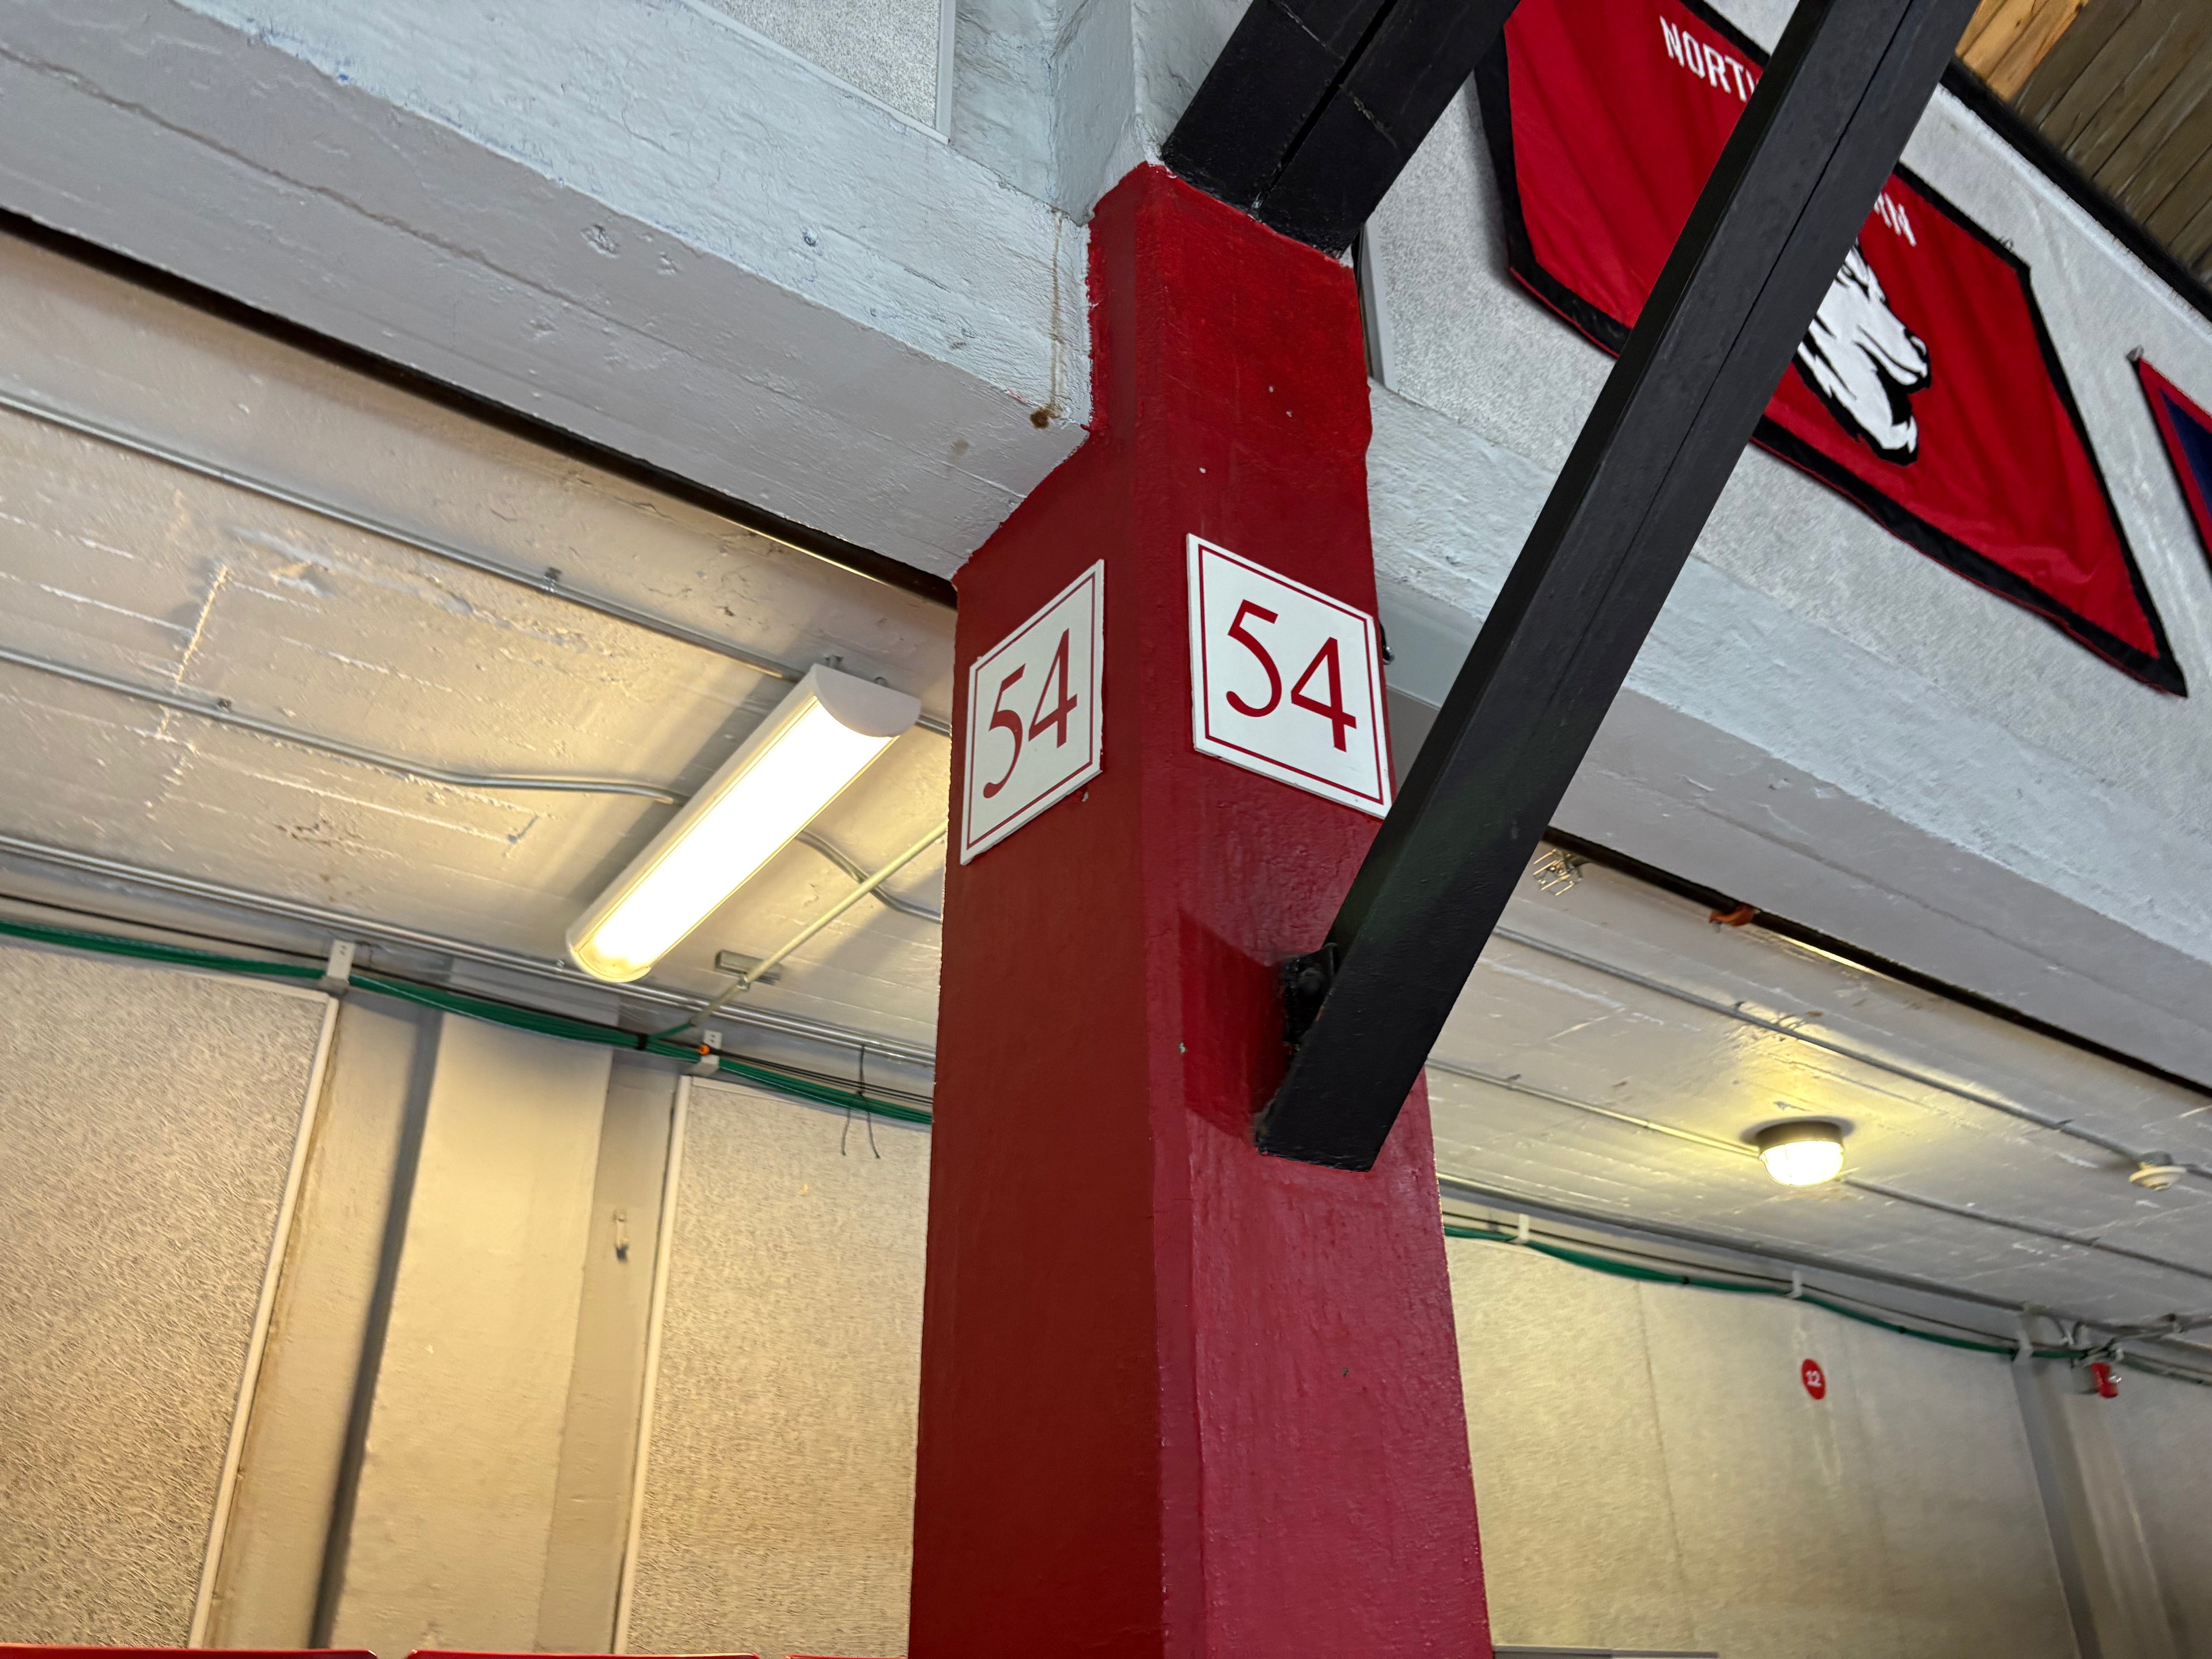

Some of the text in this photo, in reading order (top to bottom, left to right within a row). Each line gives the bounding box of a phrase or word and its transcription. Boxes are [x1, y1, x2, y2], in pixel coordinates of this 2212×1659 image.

[983, 627, 1078, 799] 54
[1226, 599, 1357, 752] 54
[1805, 1370, 1822, 1388] 12
